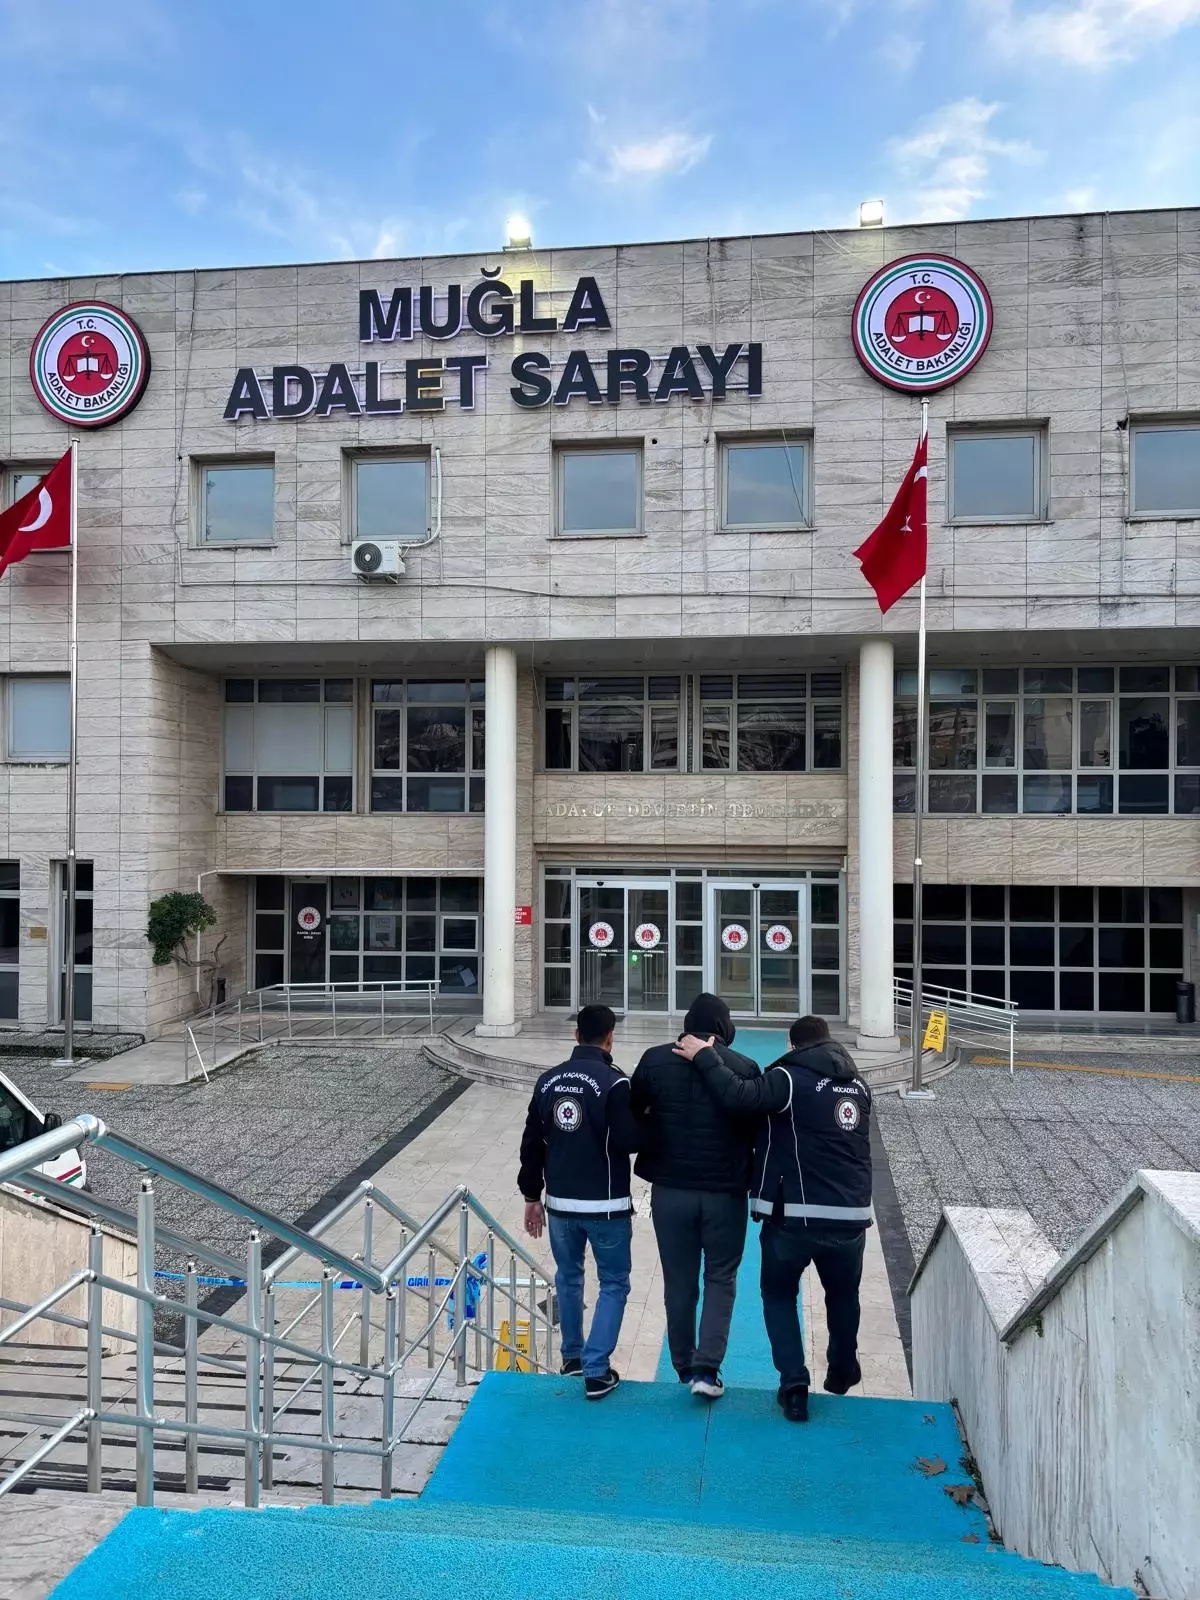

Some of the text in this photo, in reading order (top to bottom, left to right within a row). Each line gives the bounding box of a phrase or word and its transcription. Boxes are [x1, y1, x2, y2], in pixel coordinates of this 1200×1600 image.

[910, 273, 934, 285] T.C.
[77, 319, 97, 330] T.C.
[360, 267, 612, 342] MUĞLA
[873, 322, 972, 371] ADALET BAKANLIĞI
[47, 372, 81, 407] ADALET
[223, 342, 763, 421] ADALET SARAYI
